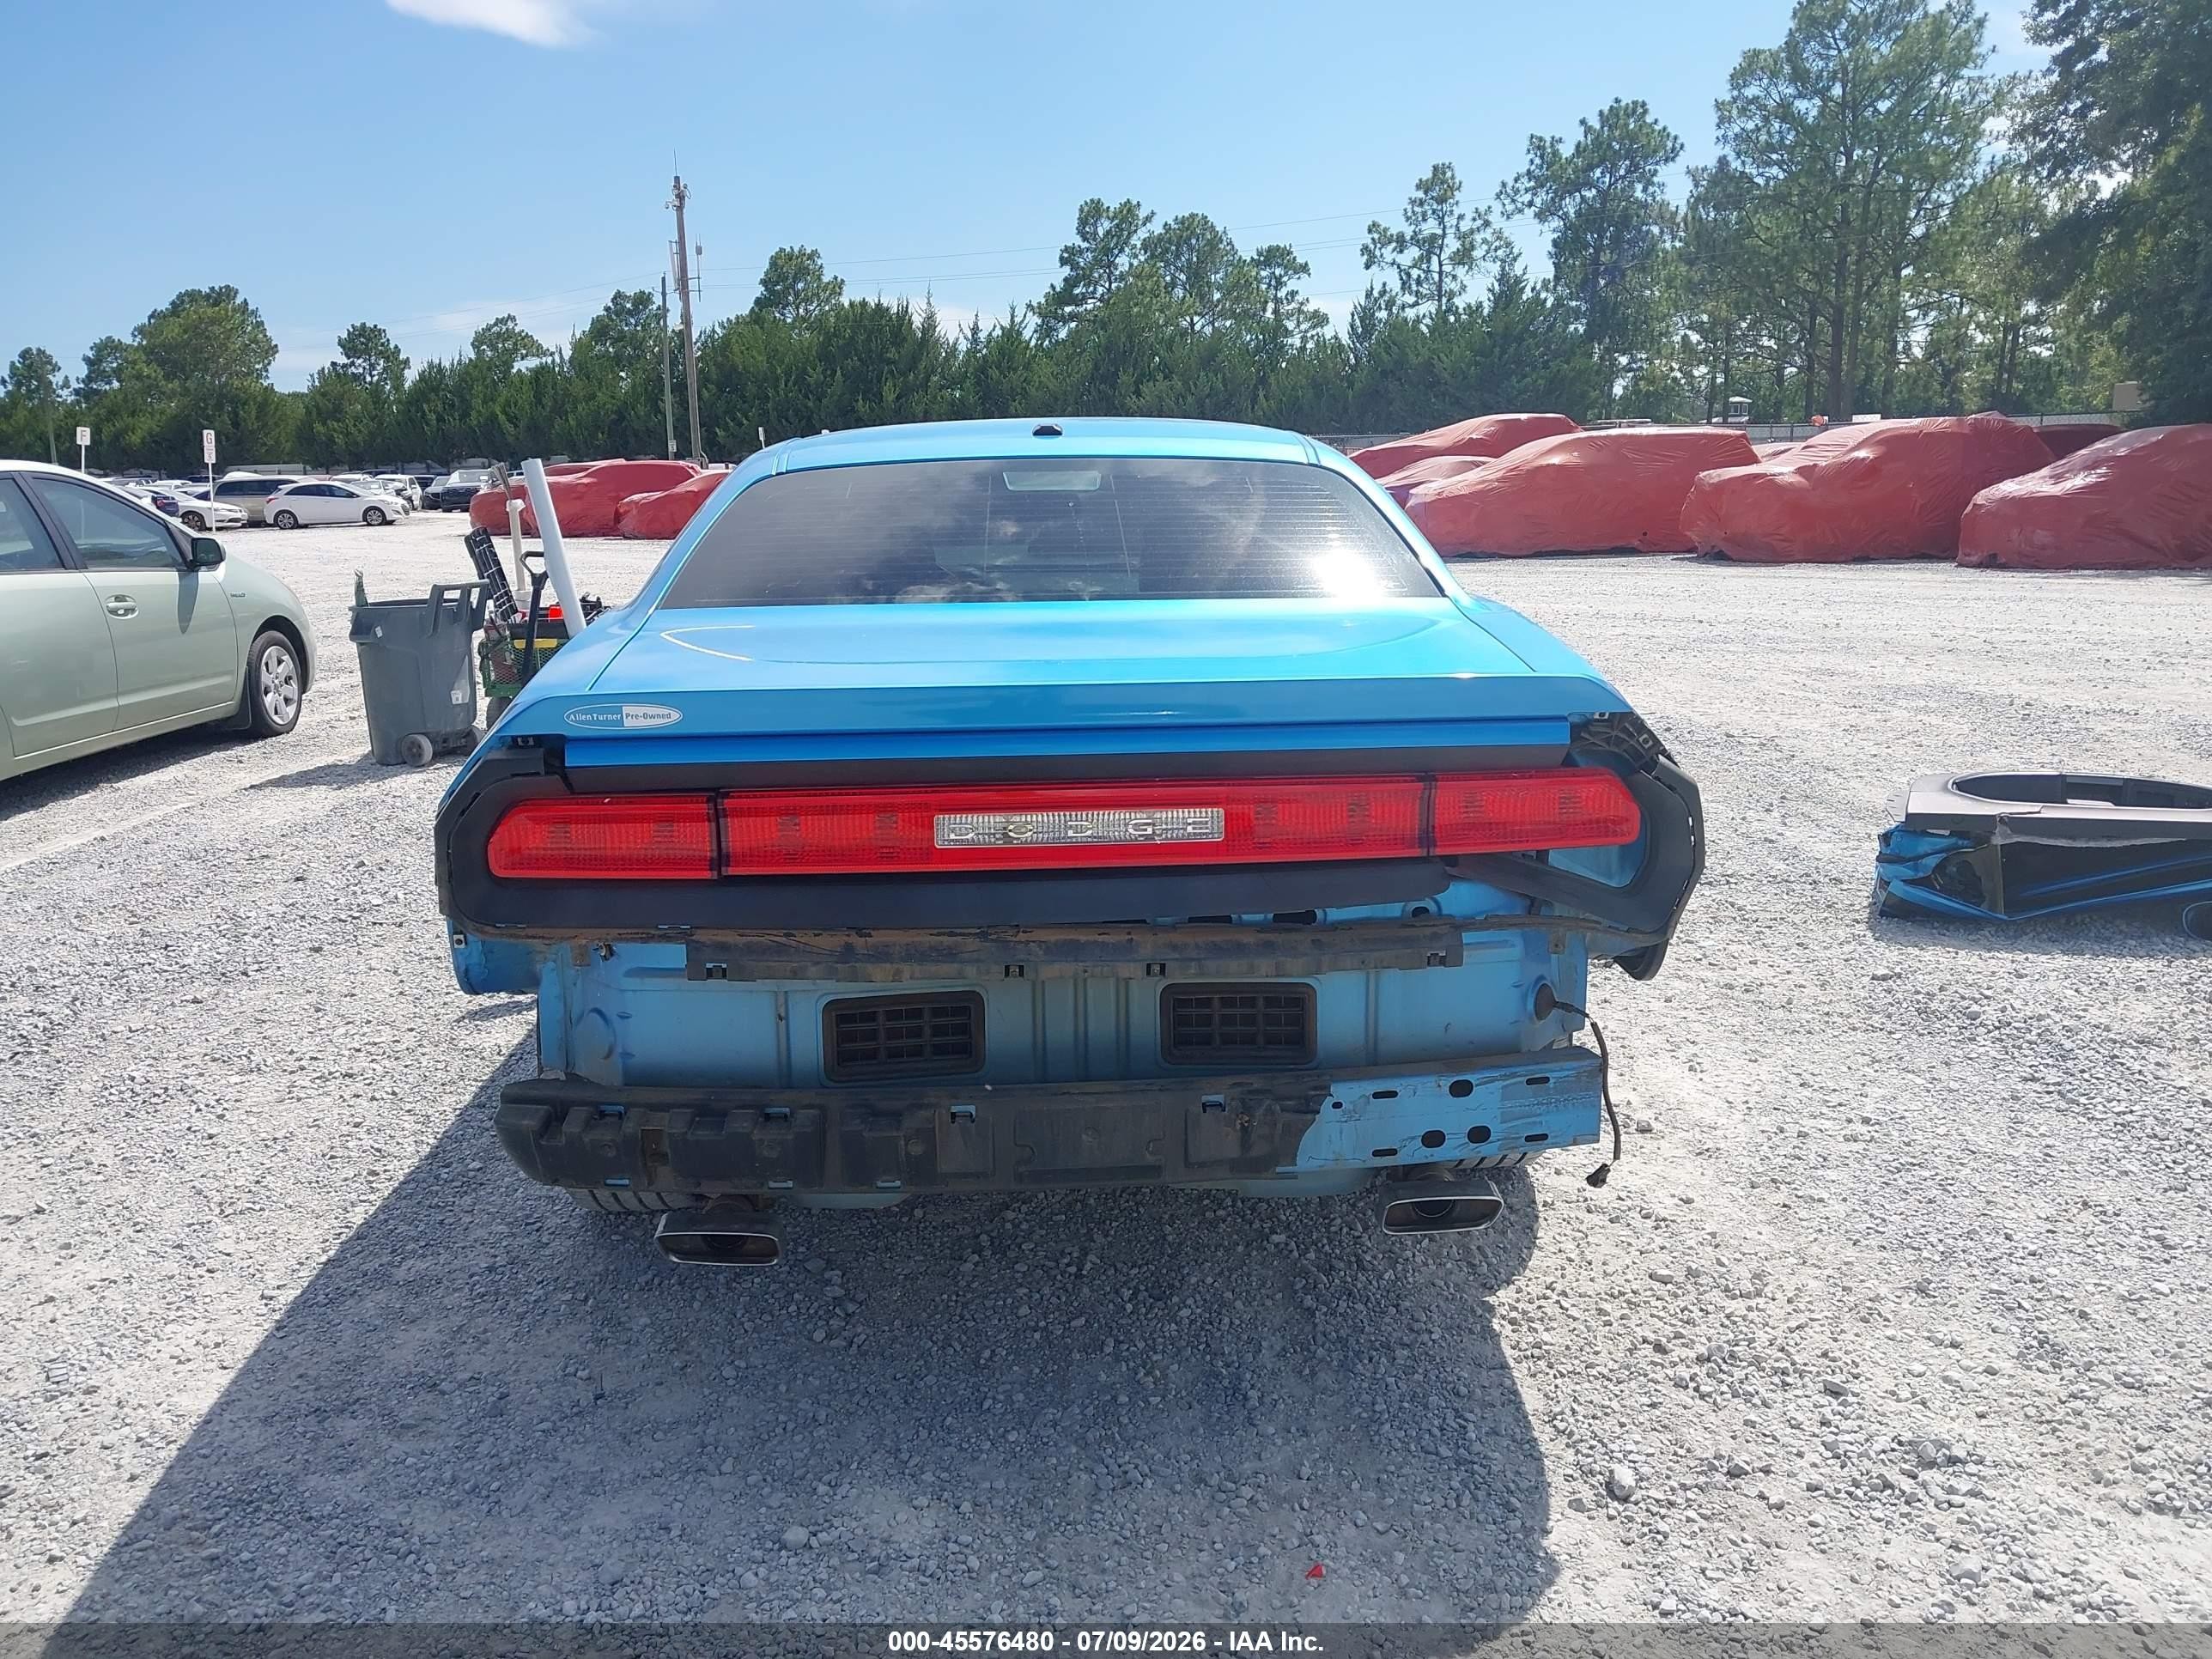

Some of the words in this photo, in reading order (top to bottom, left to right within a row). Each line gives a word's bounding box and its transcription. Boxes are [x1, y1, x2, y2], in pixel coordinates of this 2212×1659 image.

[80, 429, 87, 442] F
[206, 432, 213, 445] G
[568, 713, 592, 721] Allen
[948, 817, 1211, 839] DODGE
